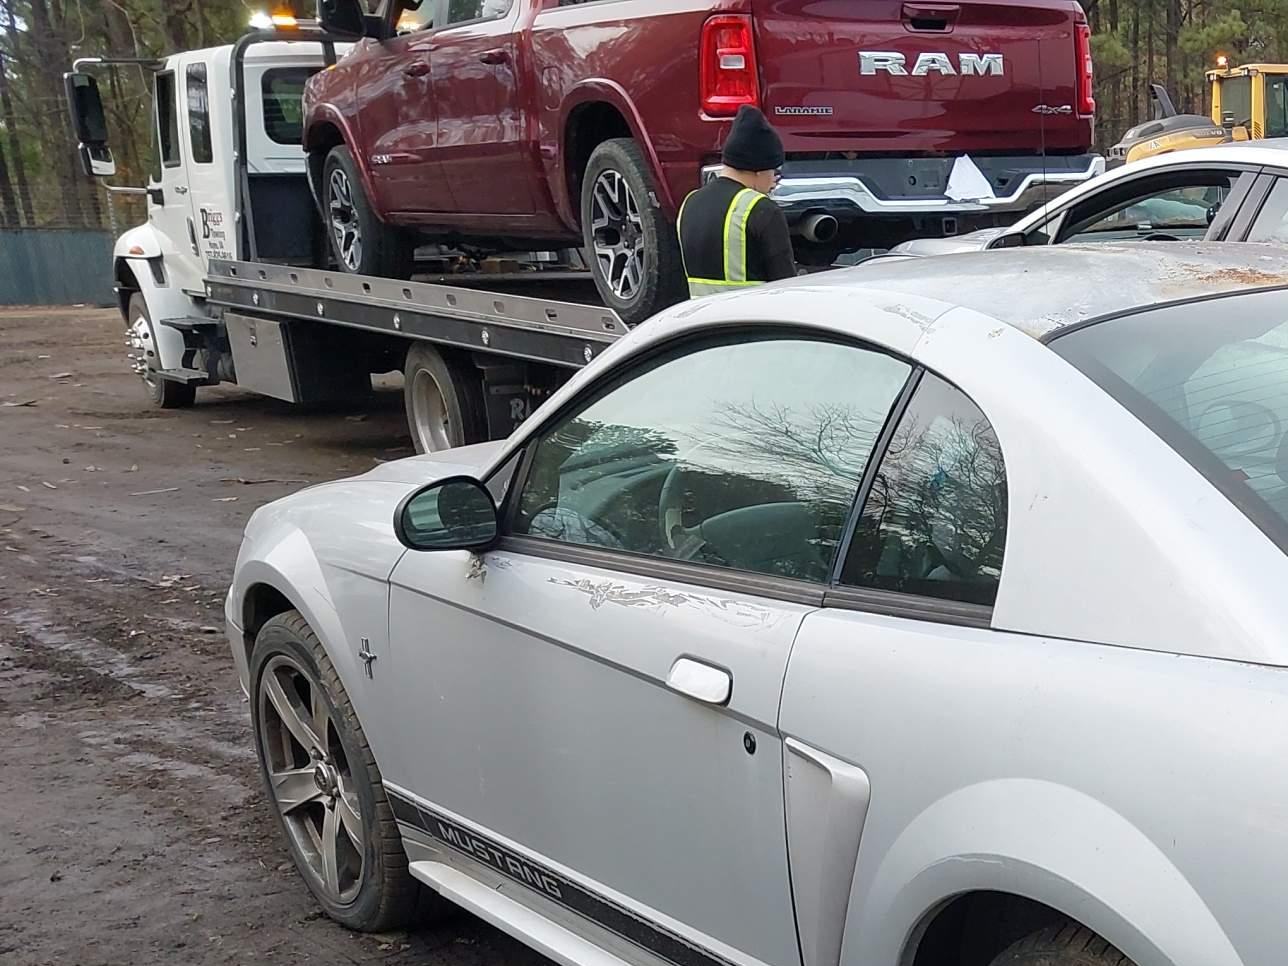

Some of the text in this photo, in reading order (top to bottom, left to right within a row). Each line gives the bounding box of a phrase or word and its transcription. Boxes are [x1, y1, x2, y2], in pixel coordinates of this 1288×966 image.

[858, 51, 1004, 76] RAM
[774, 106, 834, 115] LARAMIE
[1031, 105, 1073, 114] 4x4
[437, 822, 562, 898] MUSTANG
